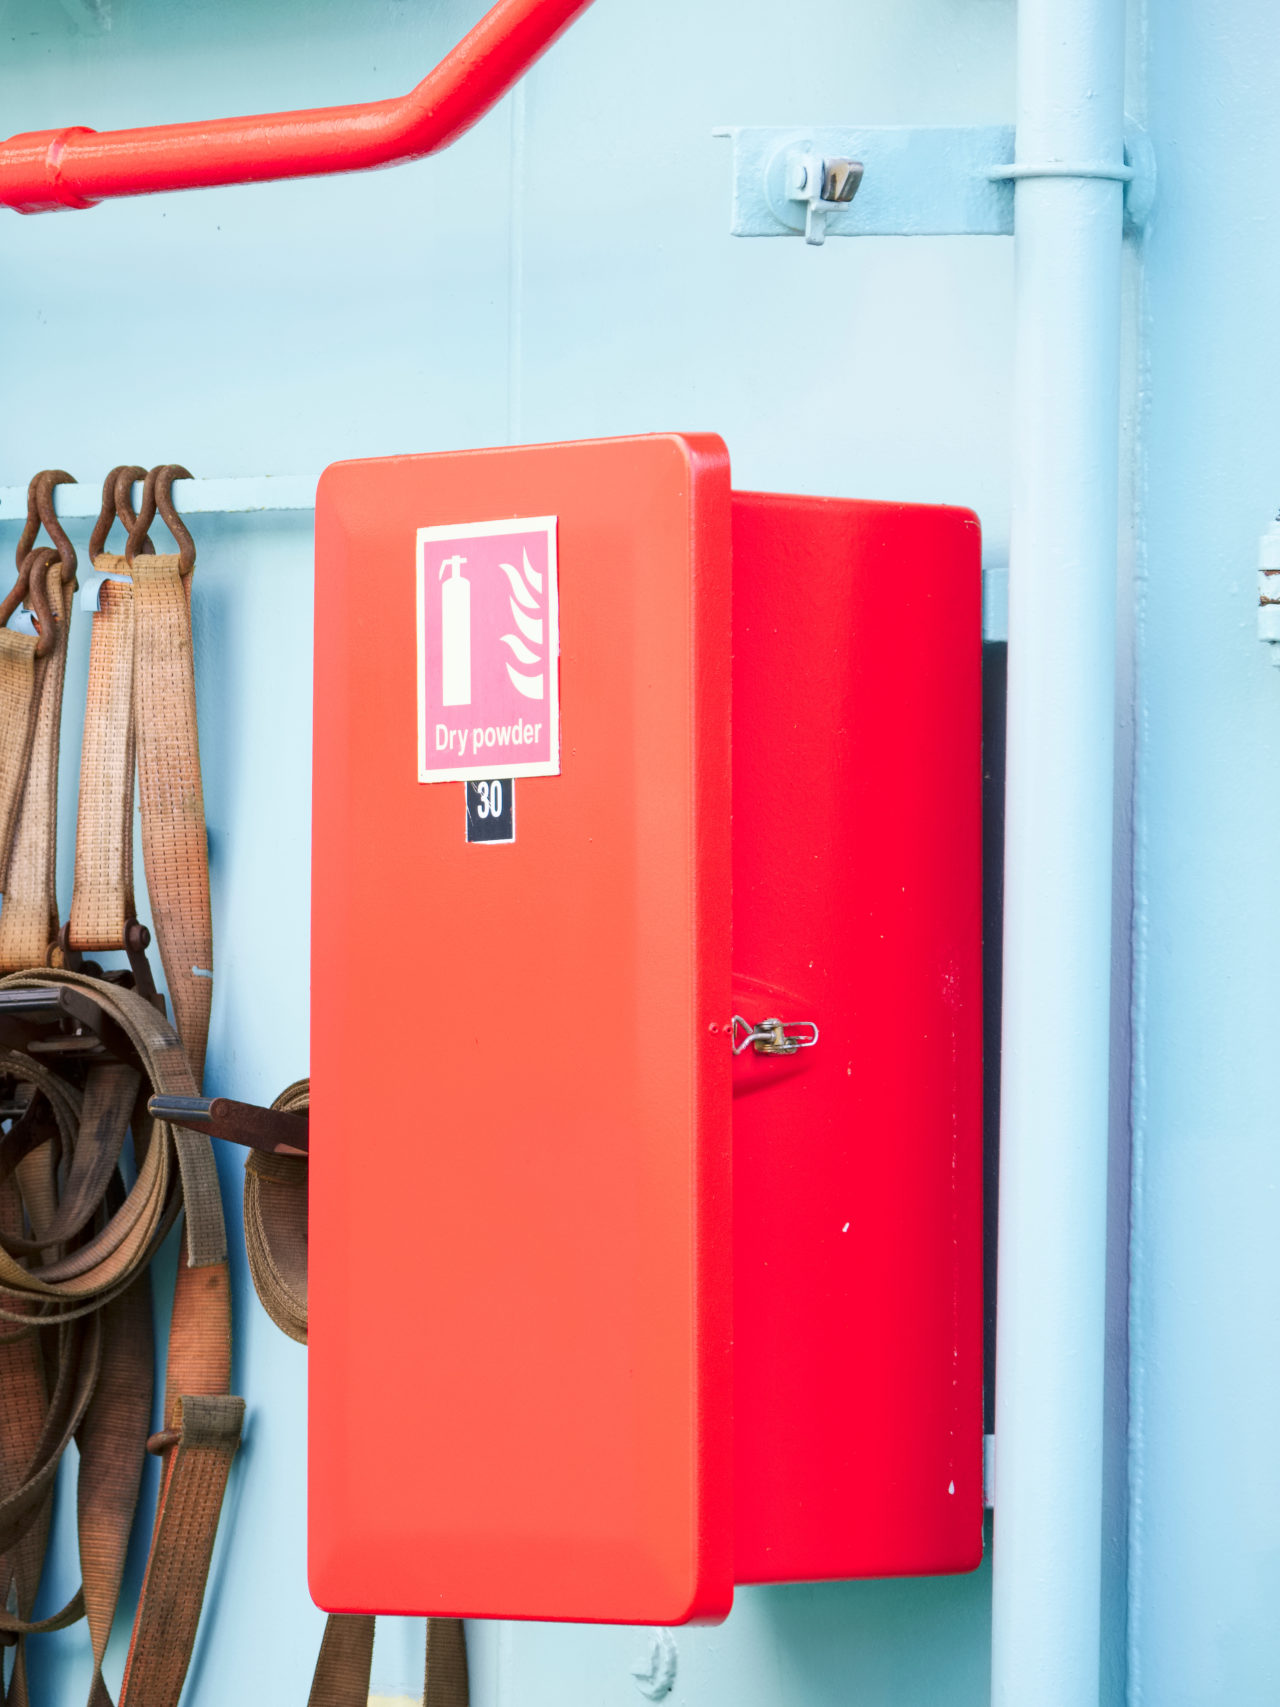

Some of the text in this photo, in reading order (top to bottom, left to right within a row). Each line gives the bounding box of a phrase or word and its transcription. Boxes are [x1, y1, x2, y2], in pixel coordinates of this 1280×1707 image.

[435, 717, 543, 756] Dry powder
[477, 780, 502, 818] 30
